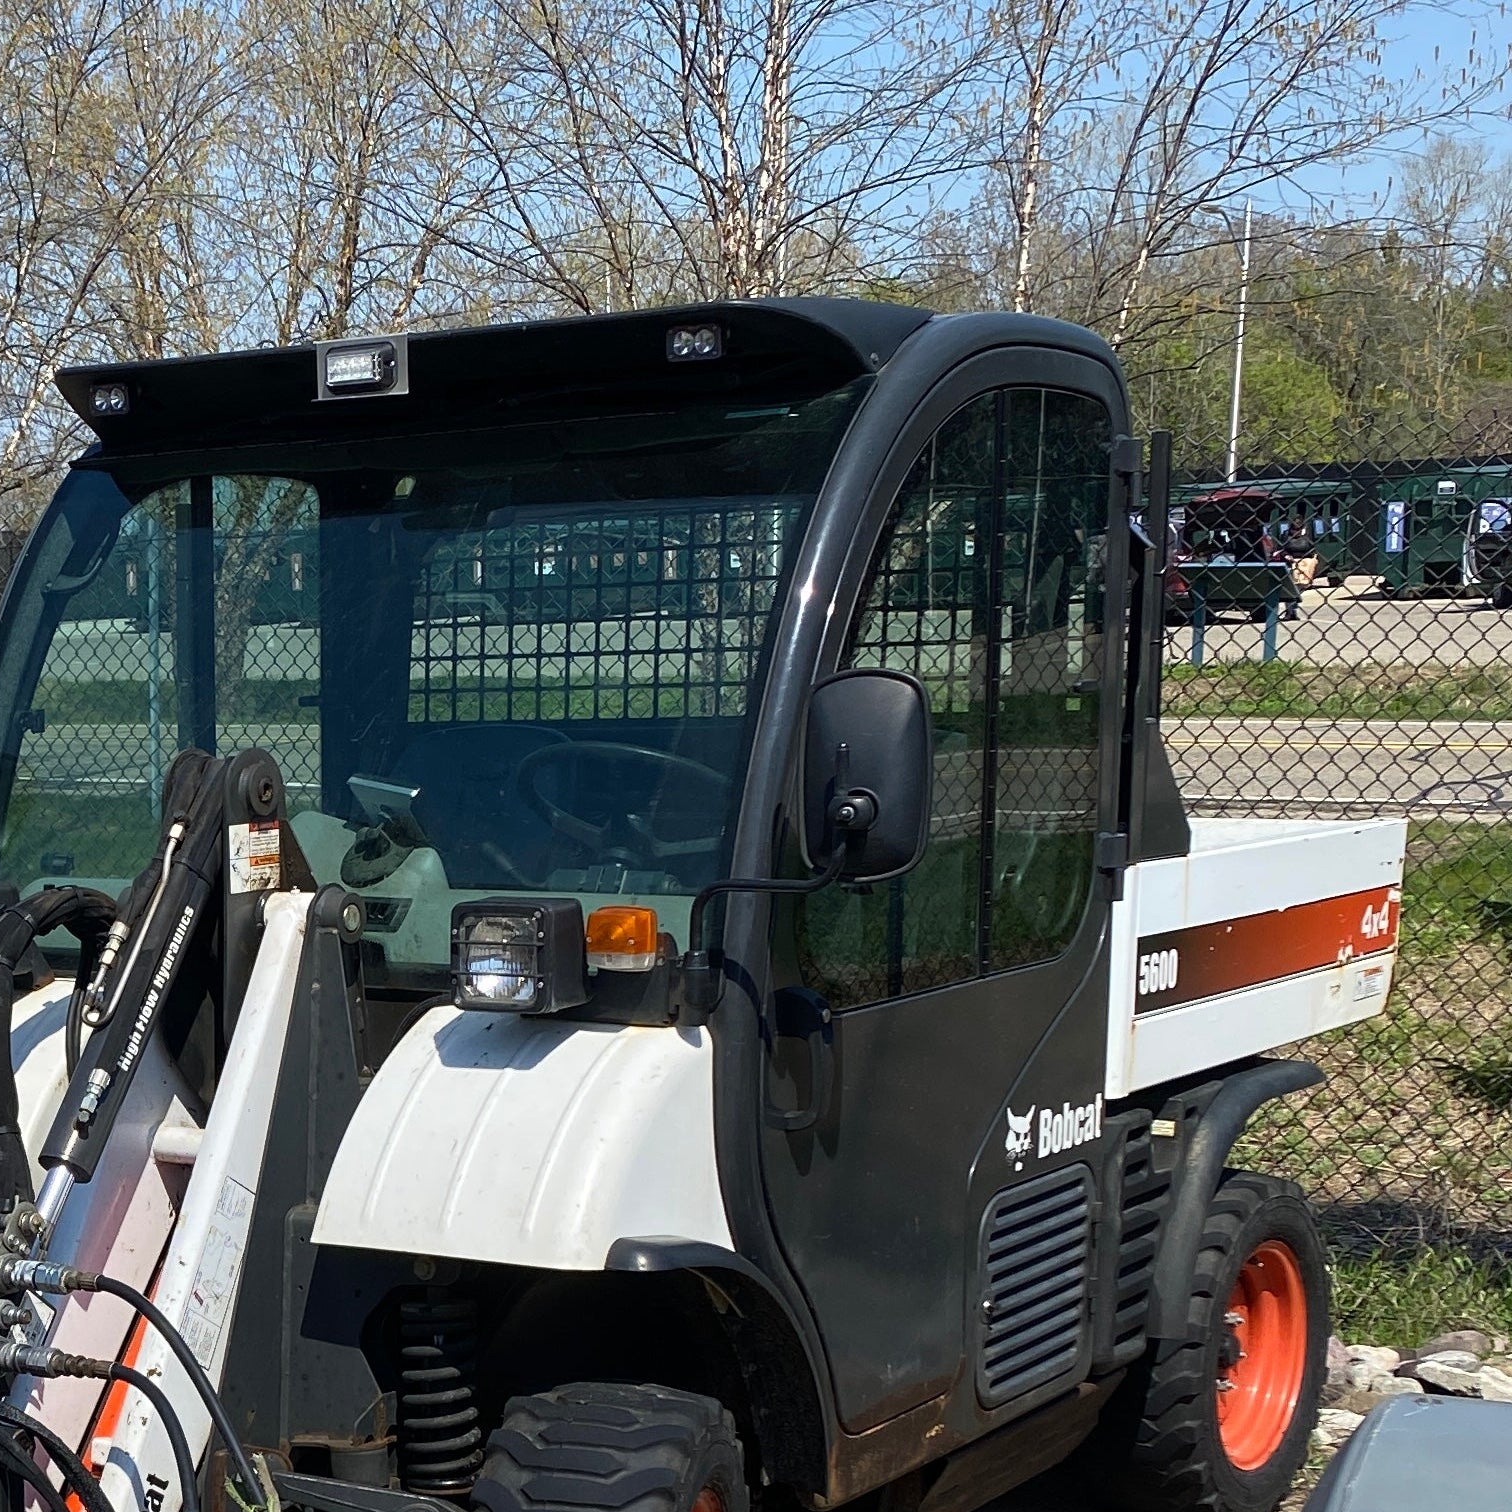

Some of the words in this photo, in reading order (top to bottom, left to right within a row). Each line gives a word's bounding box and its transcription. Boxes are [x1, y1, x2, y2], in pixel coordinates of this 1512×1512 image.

[1361, 901, 1390, 940] 4x4
[117, 1031, 141, 1072] High
[135, 988, 159, 1032] Flow
[153, 905, 194, 989] Hydraulics
[1139, 948, 1178, 996] 5600
[1038, 1092, 1103, 1158] Bobcat
